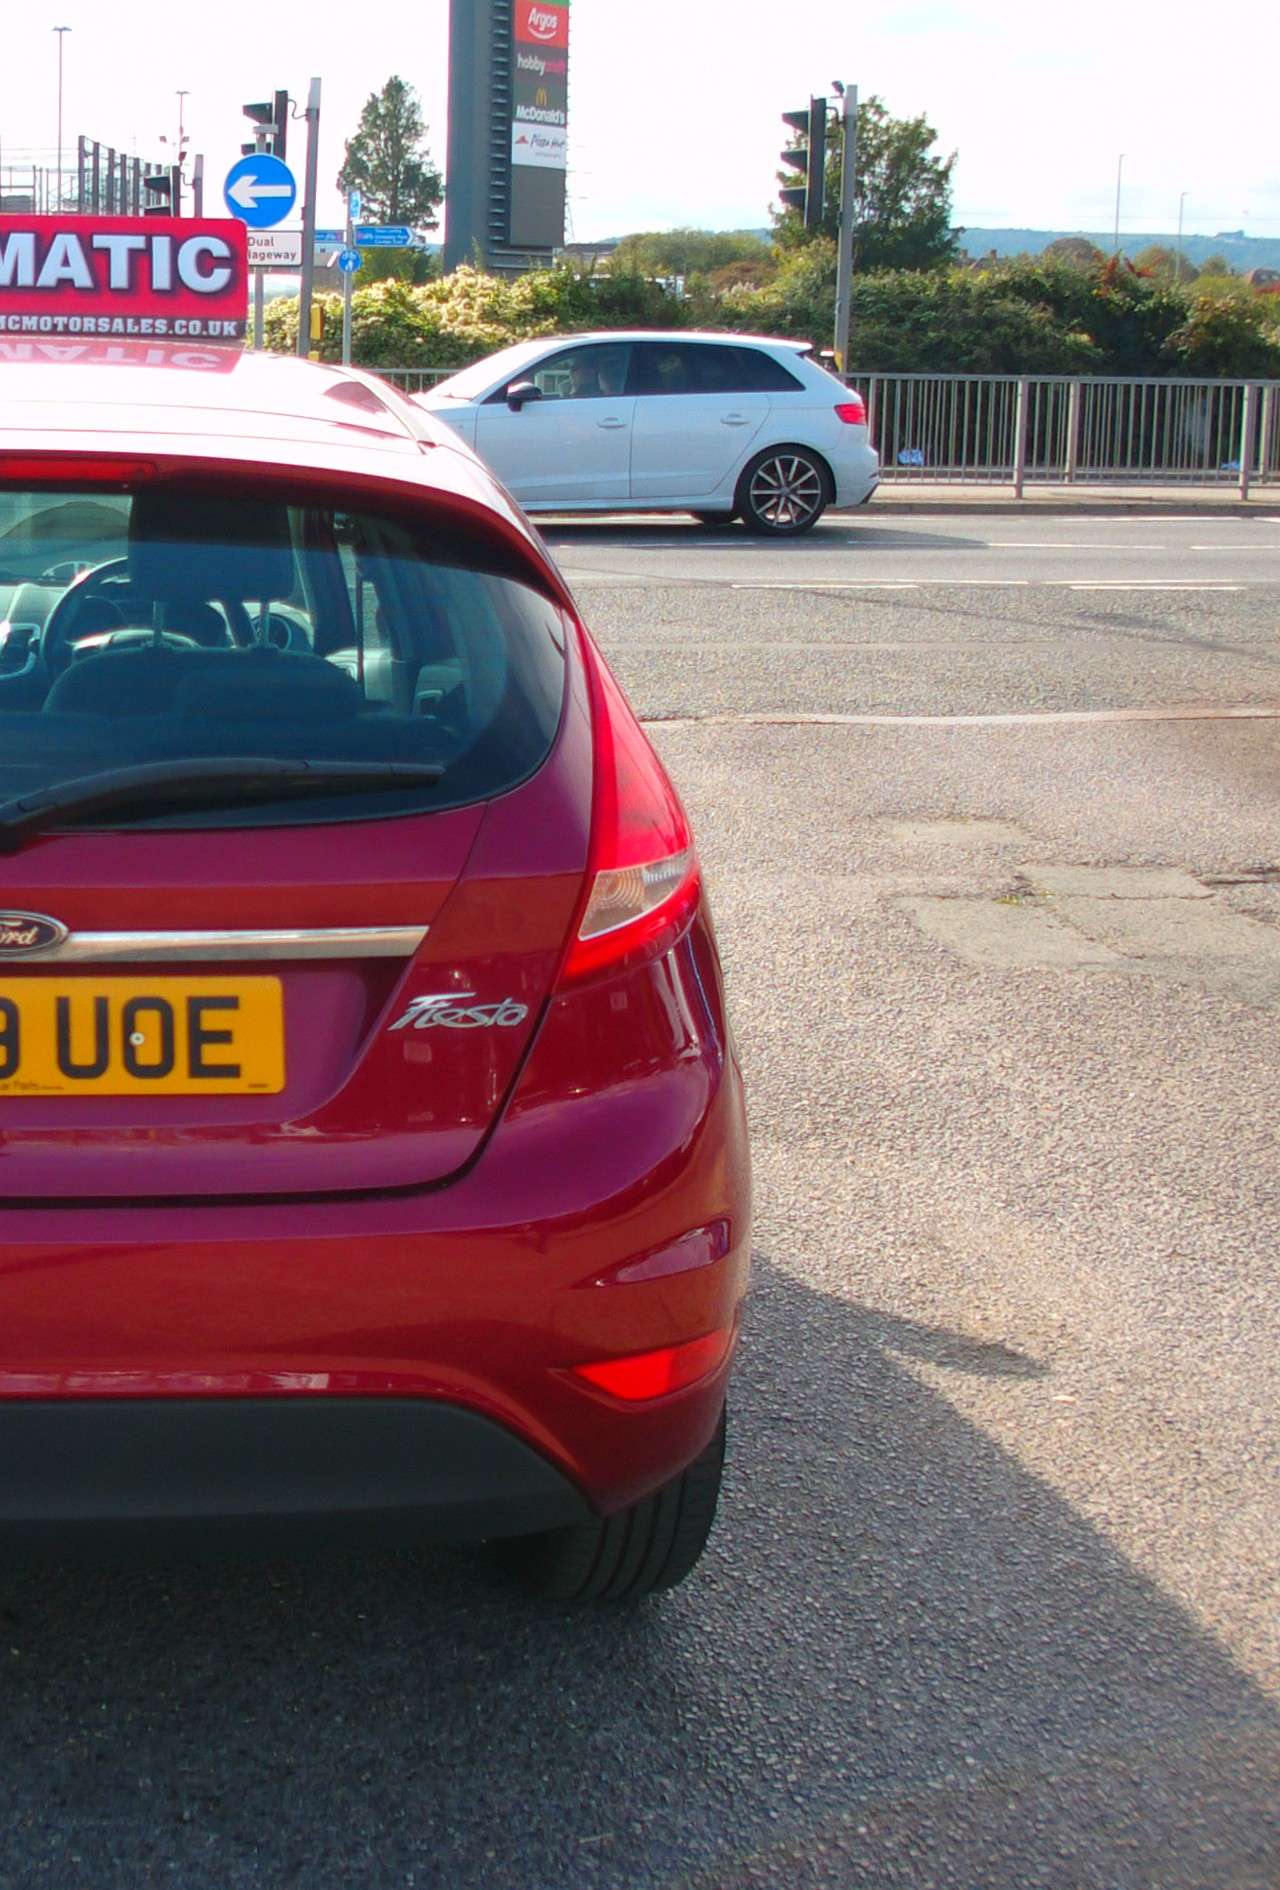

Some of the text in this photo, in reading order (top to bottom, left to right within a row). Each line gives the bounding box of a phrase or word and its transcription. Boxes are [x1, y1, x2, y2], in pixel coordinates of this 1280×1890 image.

[528, 7, 558, 31] Argos
[516, 104, 565, 125] McDonald's
[247, 236, 274, 247] Dual
[248, 249, 297, 262] iageway
[387, 992, 528, 1031] Fiesta
[55, 995, 241, 1080] UOE
